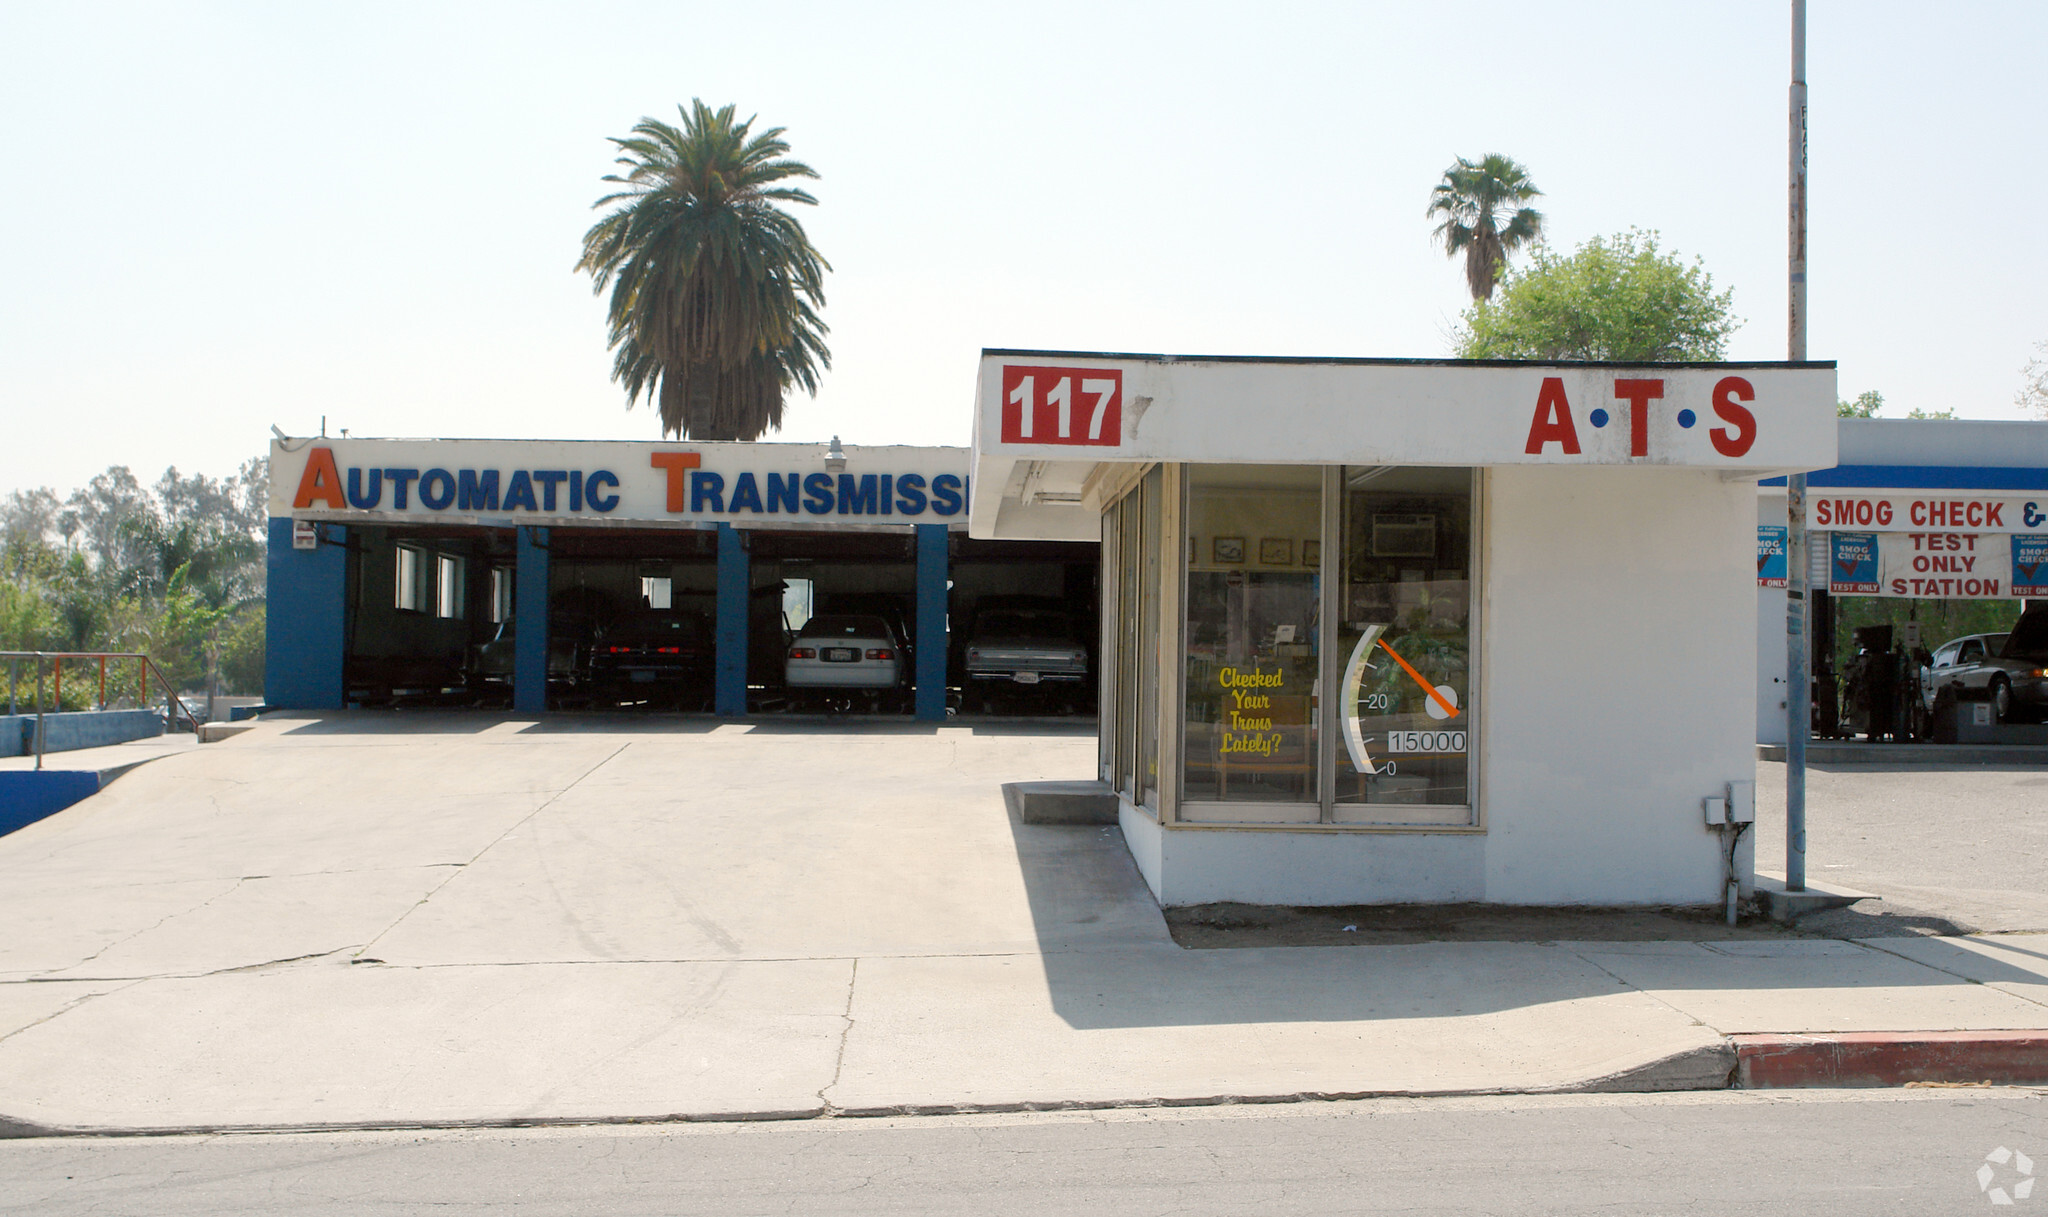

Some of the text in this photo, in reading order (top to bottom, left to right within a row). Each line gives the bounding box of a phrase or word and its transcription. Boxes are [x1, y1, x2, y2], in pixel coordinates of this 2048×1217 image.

[1009, 375, 1116, 440] 117
[292, 447, 620, 513] AUTOMATIC
[1816, 499, 2047, 527] SMOG CHECK &
[1839, 545, 1869, 553] SMOG
[1908, 533, 1979, 551] TEST
[1838, 552, 1872, 561] CHECK
[1912, 555, 1977, 573] ONLY
[1767, 580, 1788, 588] ONLY
[1832, 583, 1879, 592] TEST ONLY
[1891, 578, 1999, 596] STATION
[2012, 586, 2032, 594] TEST
[1219, 667, 1284, 688] Checked
[1231, 689, 1271, 709] Your
[1368, 693, 1388, 709] 20
[1230, 710, 1272, 731] Trans
[1220, 732, 1282, 757] Lately?
[1391, 732, 1466, 751] 15000
[1386, 760, 1397, 776] 0
